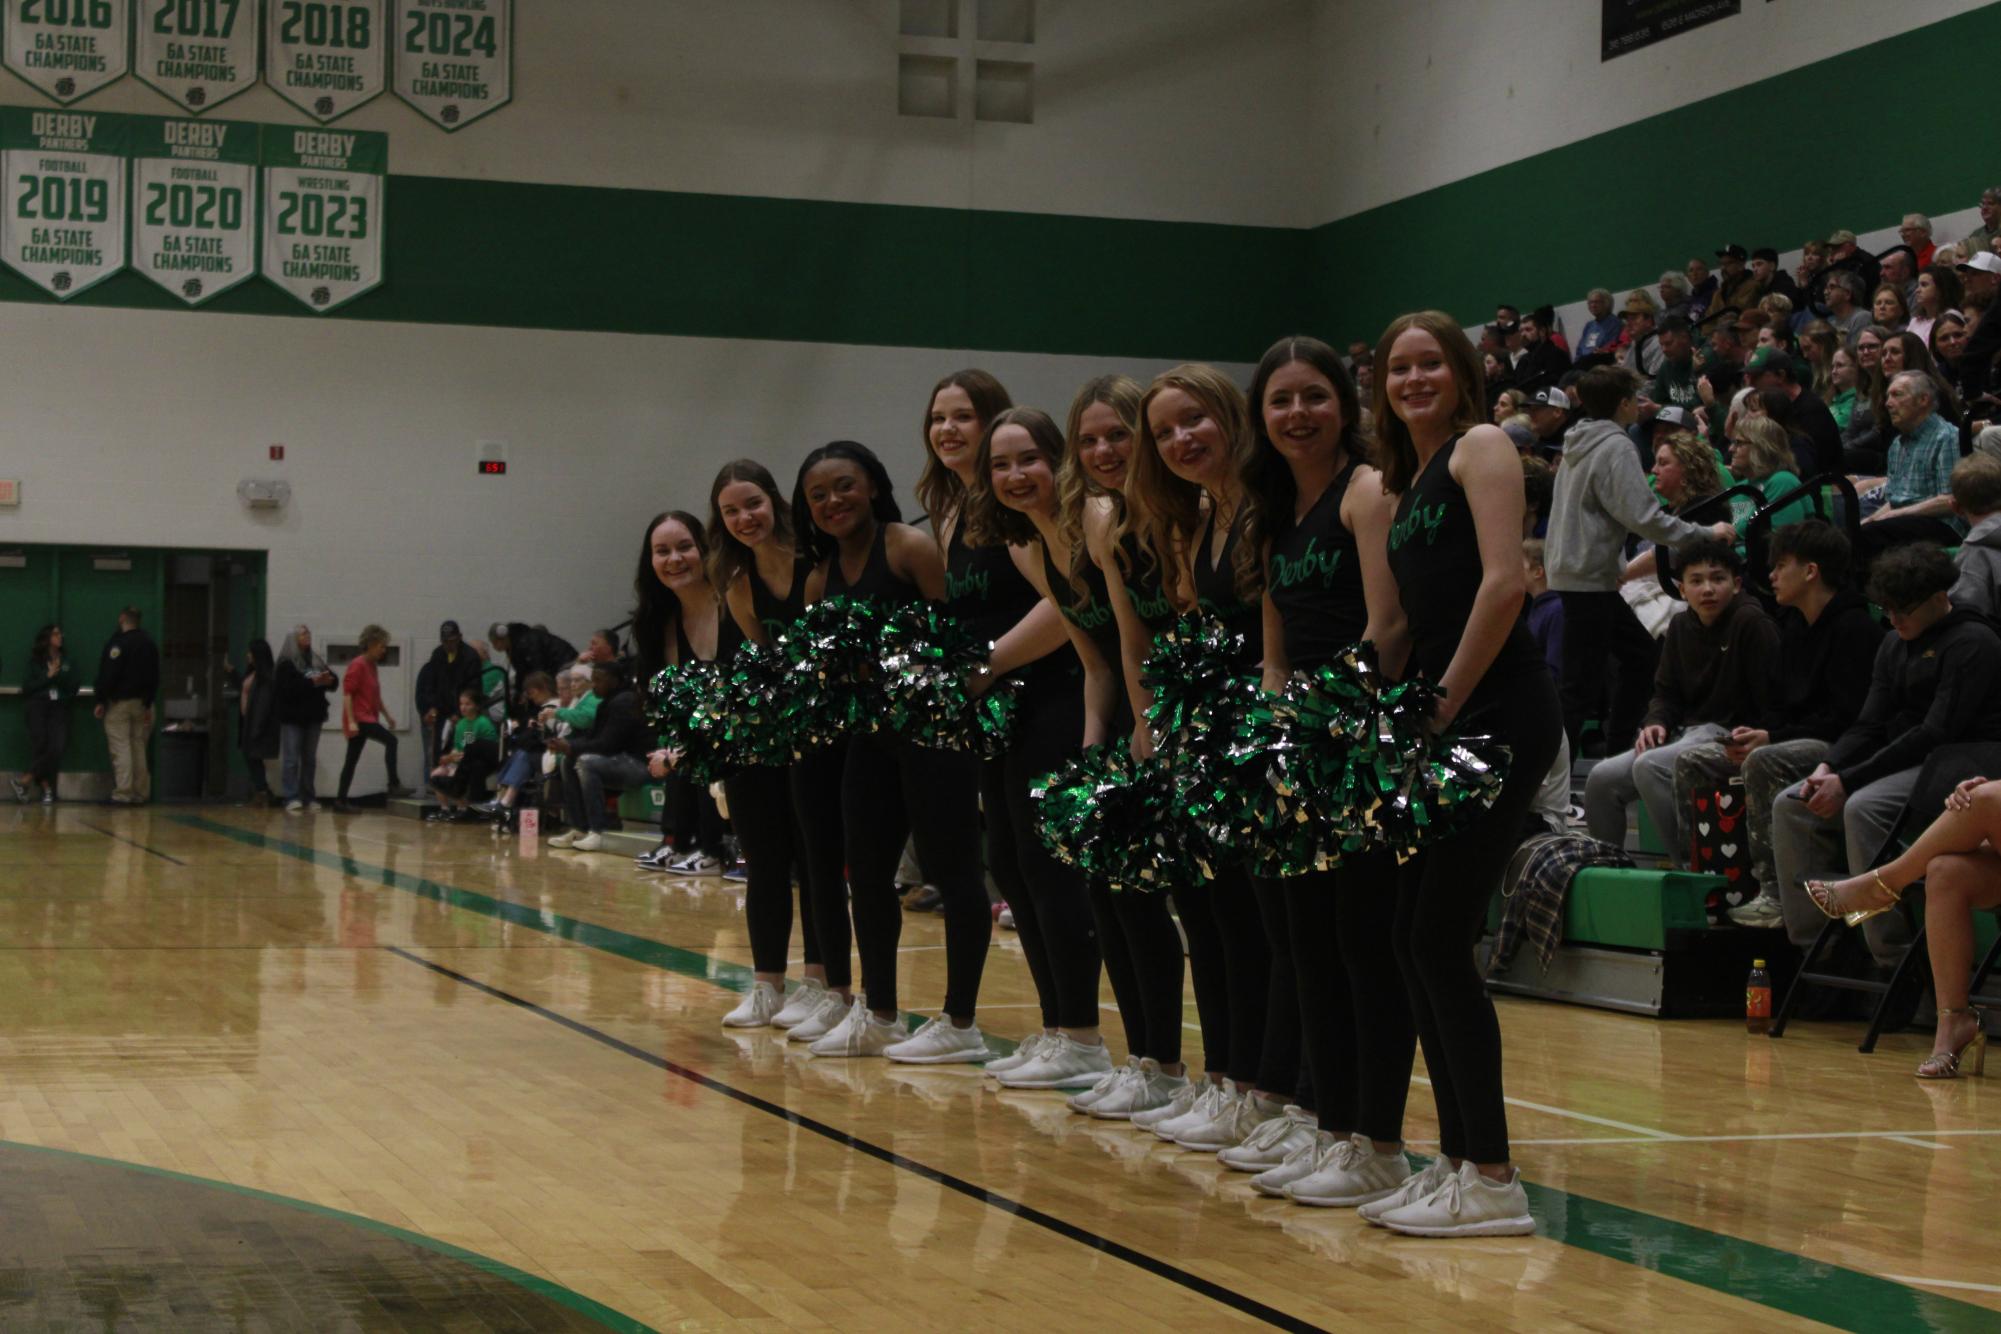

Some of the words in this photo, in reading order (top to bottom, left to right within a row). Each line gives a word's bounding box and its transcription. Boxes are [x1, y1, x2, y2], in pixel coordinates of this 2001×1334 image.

[154, 0, 240, 38] 2017
[281, 1, 370, 49] 2018
[35, 33, 53, 50] 6A
[57, 34, 96, 53] STATE
[406, 10, 496, 58] 2024
[25, 50, 106, 72] CHAMPIONS
[167, 43, 184, 60] 6A
[189, 45, 226, 63] STATE
[296, 53, 313, 70] 6A
[317, 54, 354, 73] STATE
[157, 60, 236, 82] CHAMPIONS
[286, 70, 364, 91] CHAMPIONS
[422, 62, 439, 79] 6A
[443, 64, 479, 82] STATE
[412, 79, 488, 100] CHAMPIONS
[32, 112, 97, 139] DERBY
[164, 121, 228, 148] DERBY
[293, 131, 356, 158] DERBY
[39, 159, 87, 173] FOOTBALL
[171, 167, 218, 181] FOOTBALL
[17, 175, 108, 223] 2019
[145, 182, 242, 230] 2020
[277, 191, 367, 239] 2023
[31, 228, 49, 245] 6A
[54, 229, 93, 247] STATE
[163, 235, 181, 253] 6A
[185, 236, 223, 255] STATE
[21, 246, 102, 266] CHAMPIONS
[153, 253, 233, 273] CHAMPIONS
[292, 243, 310, 261] 6A
[314, 244, 351, 263] STATE
[282, 261, 360, 282] CHAMPIONS
[1388, 494, 1448, 546] erby
[1270, 536, 1342, 592] Derby
